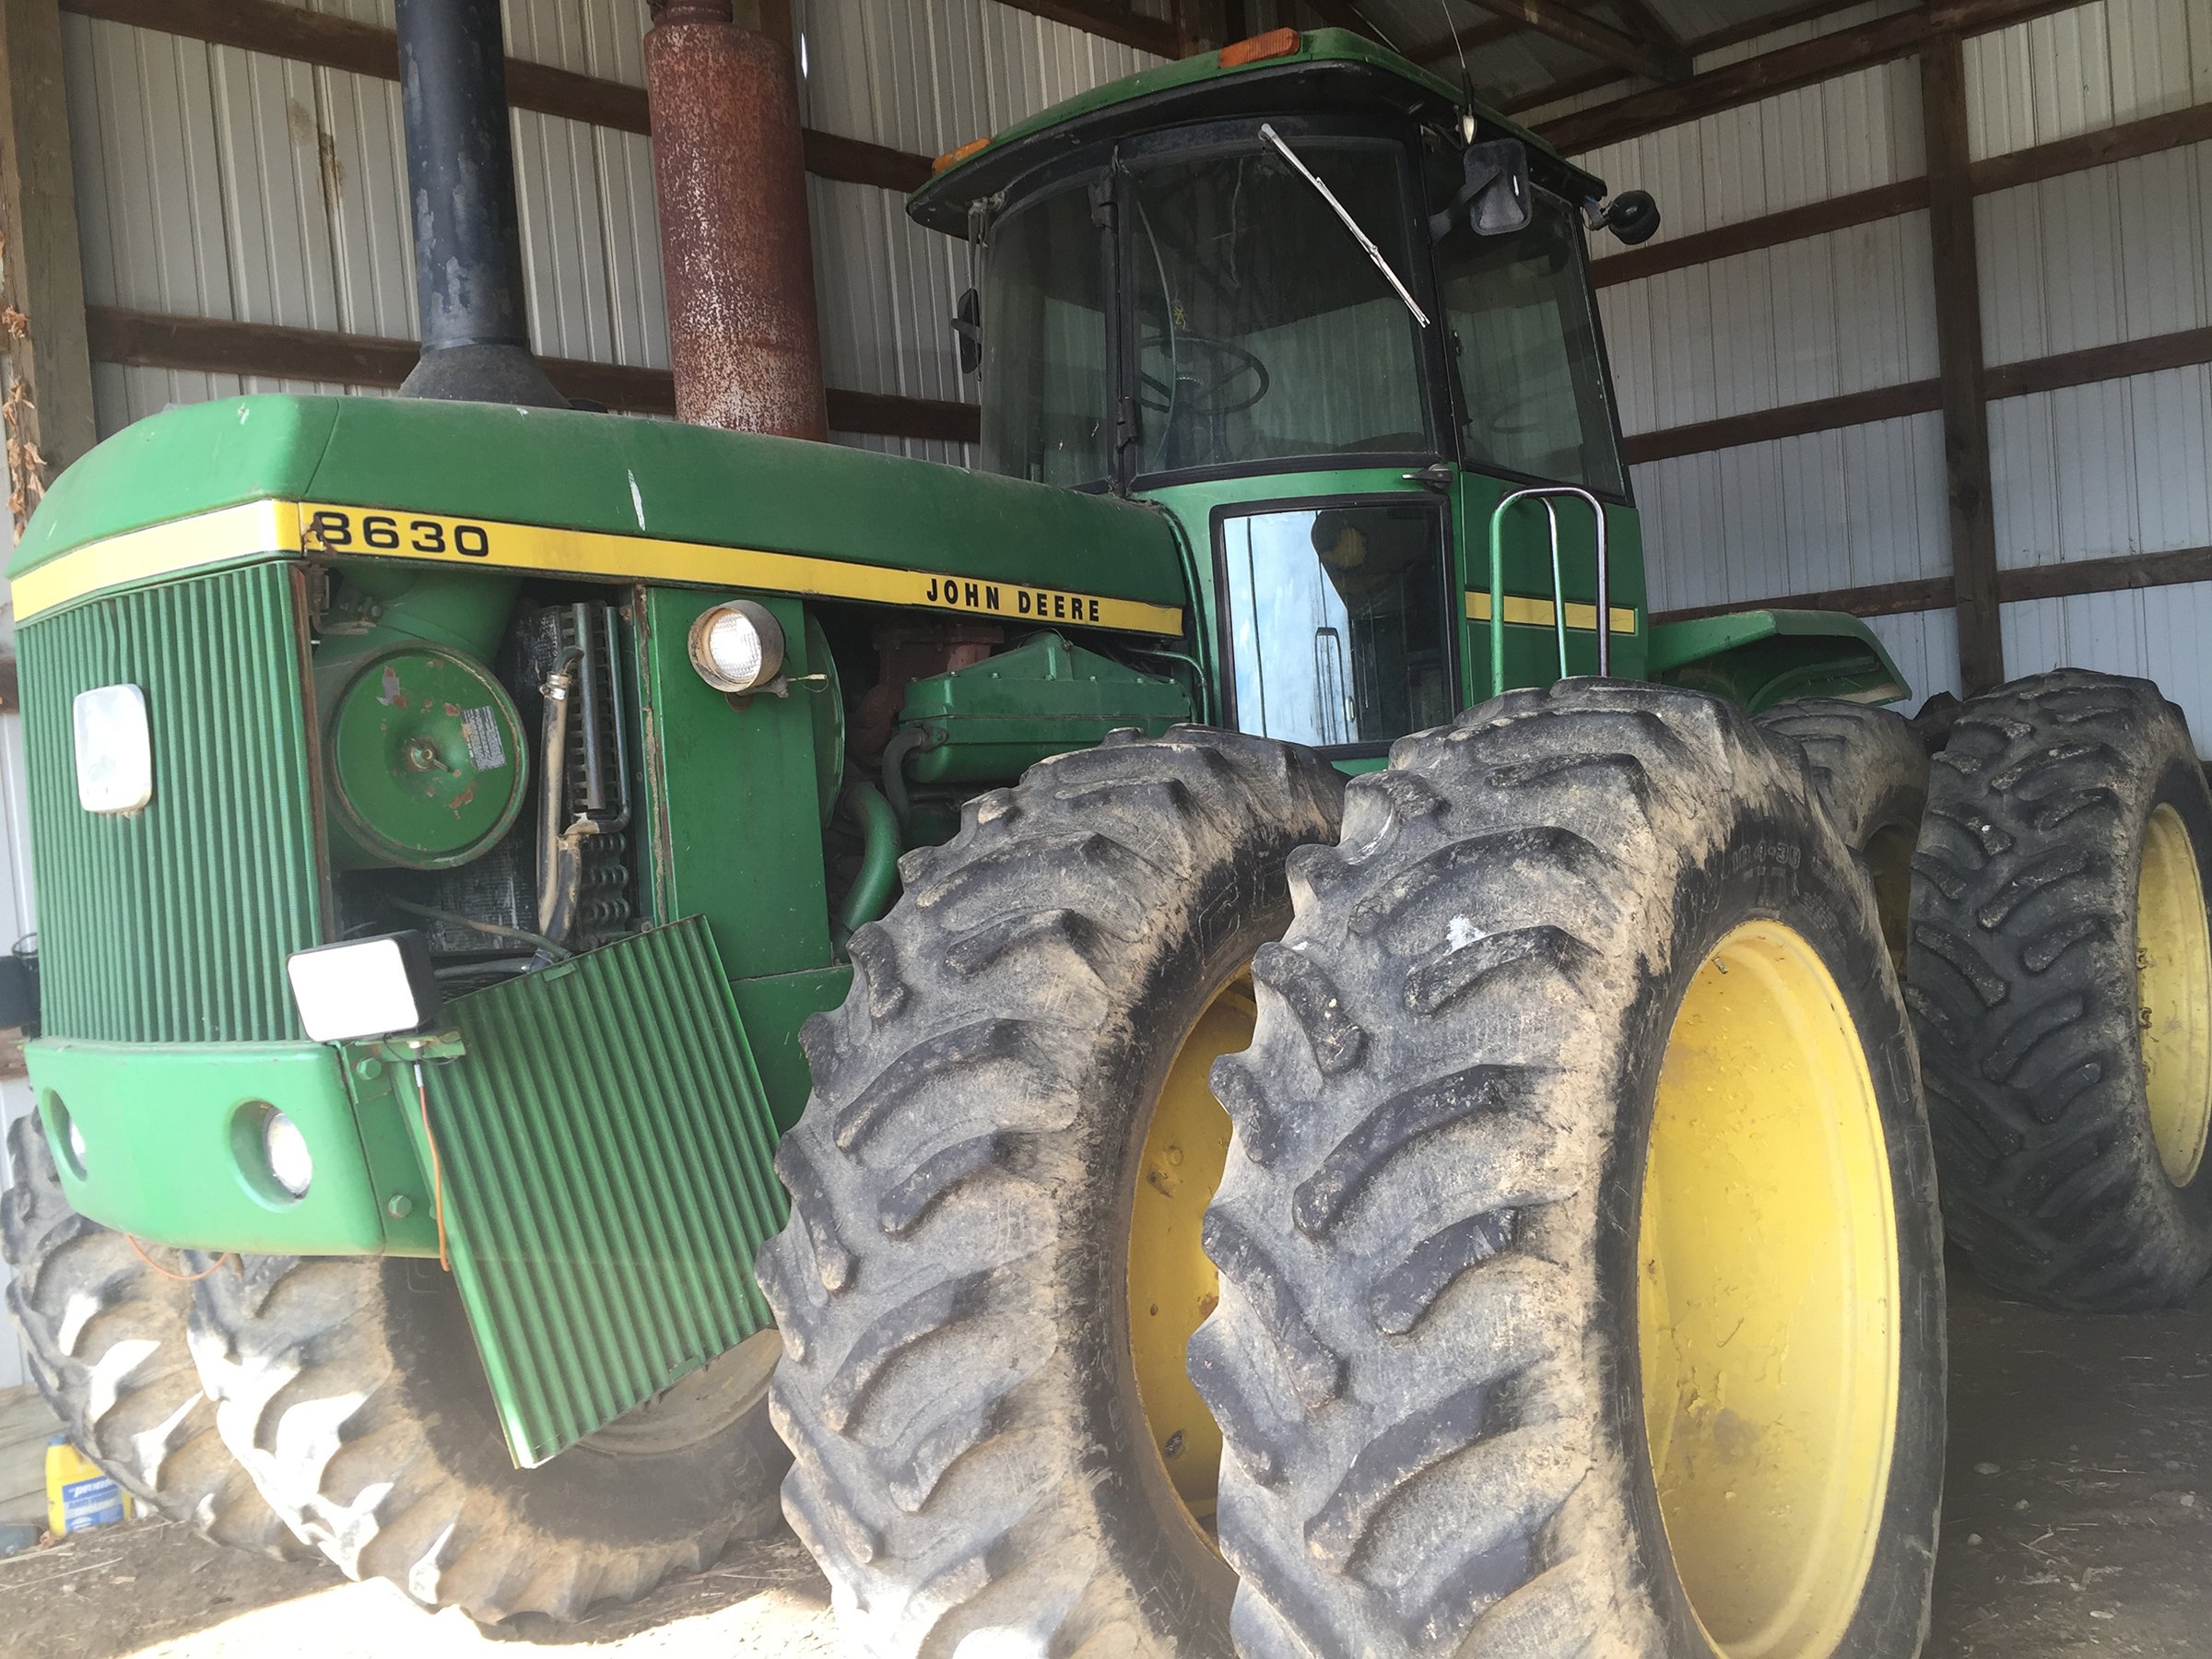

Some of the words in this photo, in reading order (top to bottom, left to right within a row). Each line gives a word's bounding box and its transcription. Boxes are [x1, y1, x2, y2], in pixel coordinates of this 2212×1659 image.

[312, 512, 489, 557] 8630
[926, 578, 999, 610] JOHN
[1018, 591, 1100, 622] DEERE
